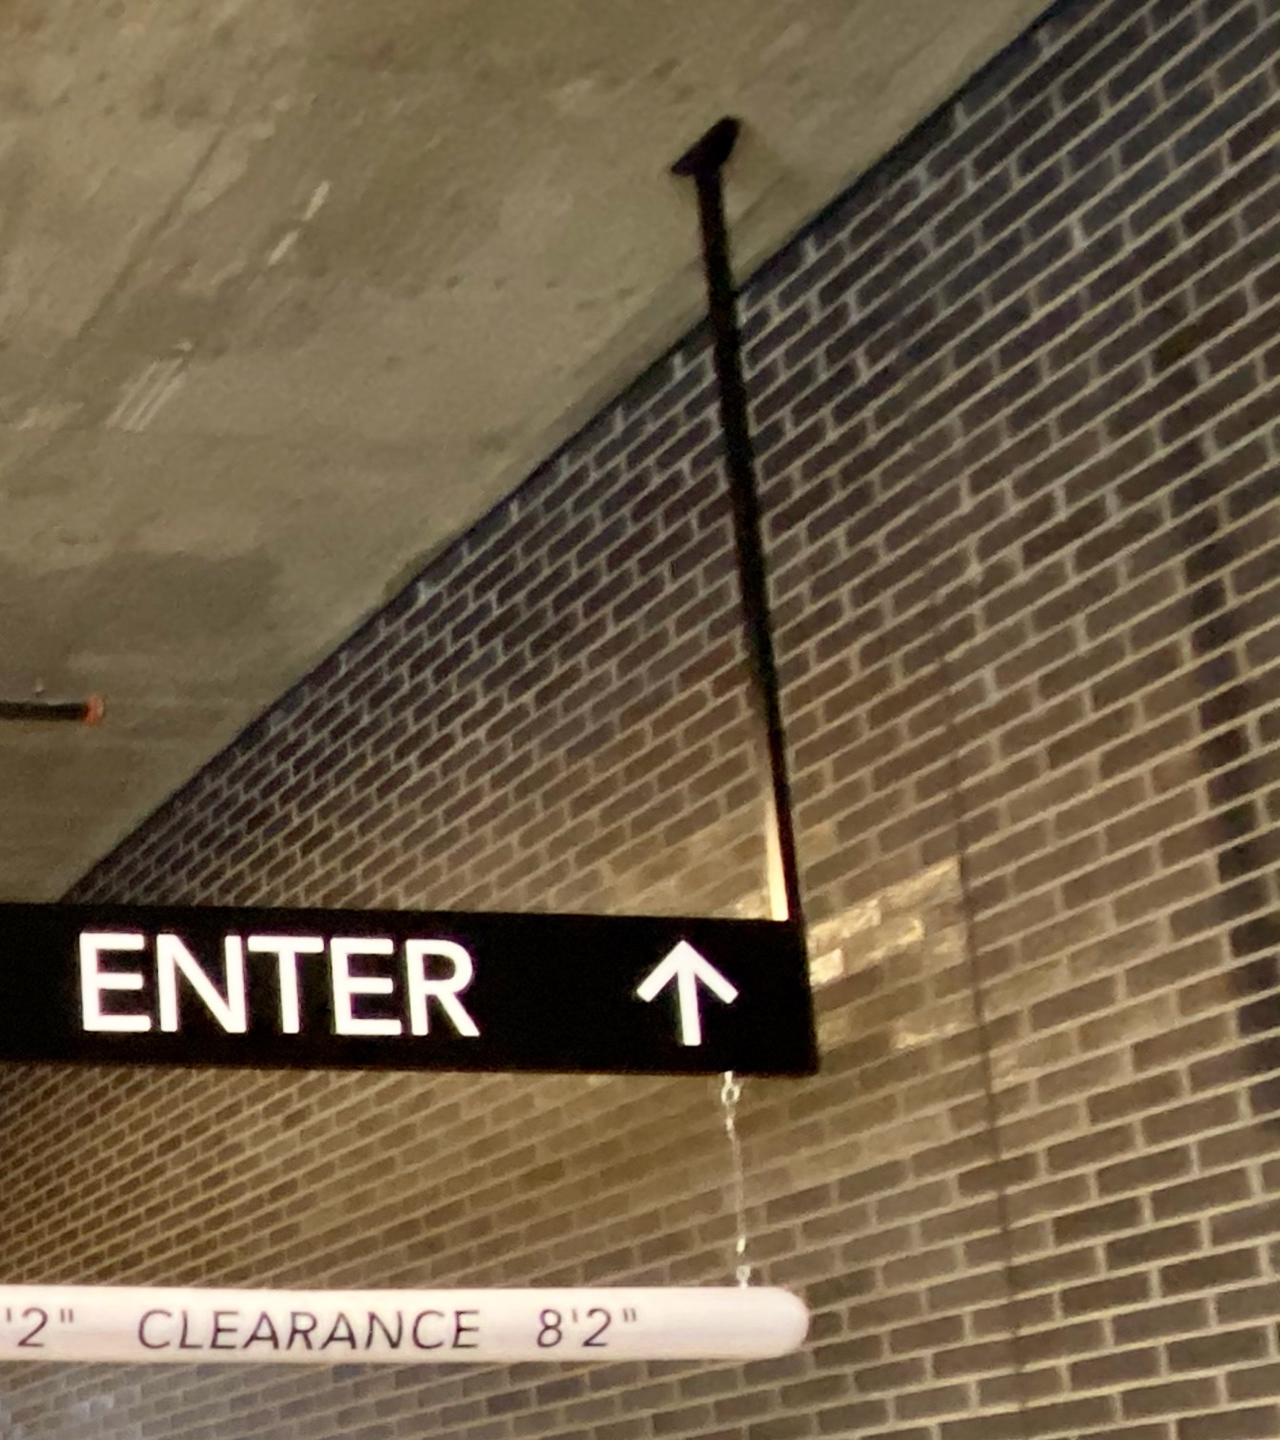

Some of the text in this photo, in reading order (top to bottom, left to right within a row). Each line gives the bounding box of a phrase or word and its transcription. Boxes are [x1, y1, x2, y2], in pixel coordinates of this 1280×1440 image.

[79, 932, 481, 1036] ENTER
[138, 1309, 480, 1350] CLEARANCE
[537, 1308, 637, 1348] 8'2"
